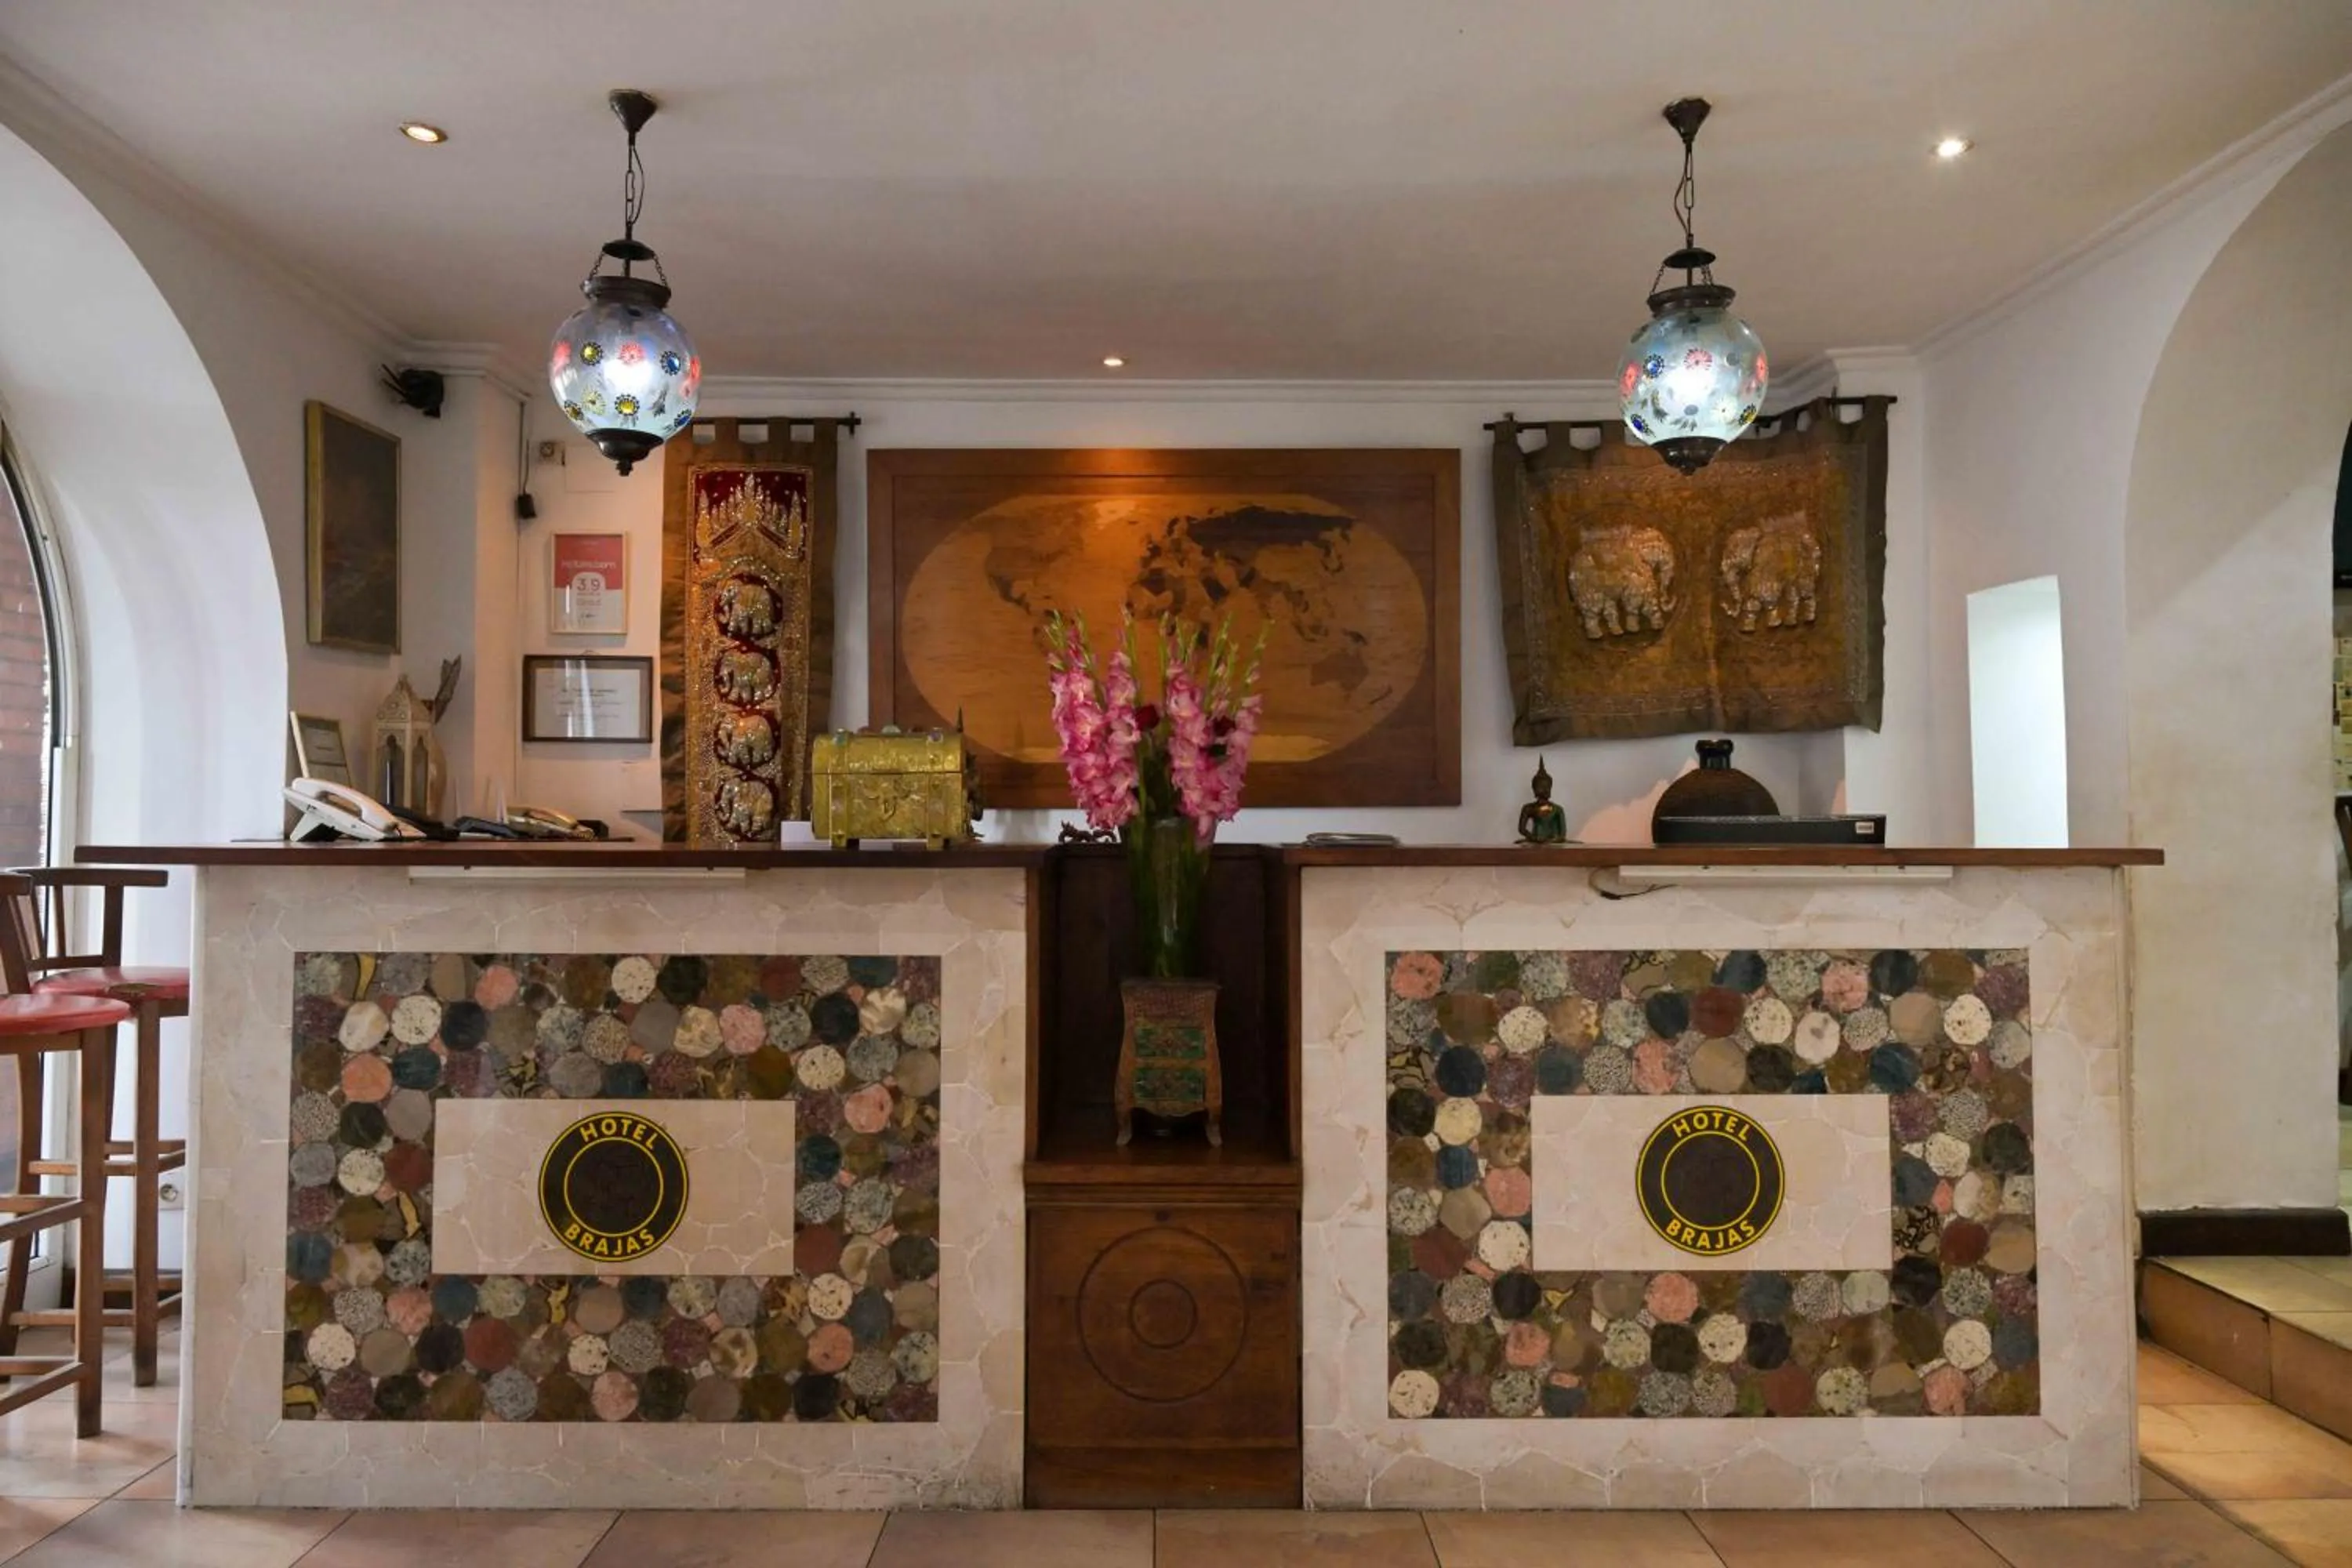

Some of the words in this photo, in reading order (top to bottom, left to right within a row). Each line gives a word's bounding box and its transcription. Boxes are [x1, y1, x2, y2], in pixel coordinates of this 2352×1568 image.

[579, 1119, 659, 1150] HOTEL
[1671, 1112, 1751, 1141] HOTEL
[564, 1222, 655, 1256] BRAJAS
[1666, 1219, 1755, 1249] BRAJAS
